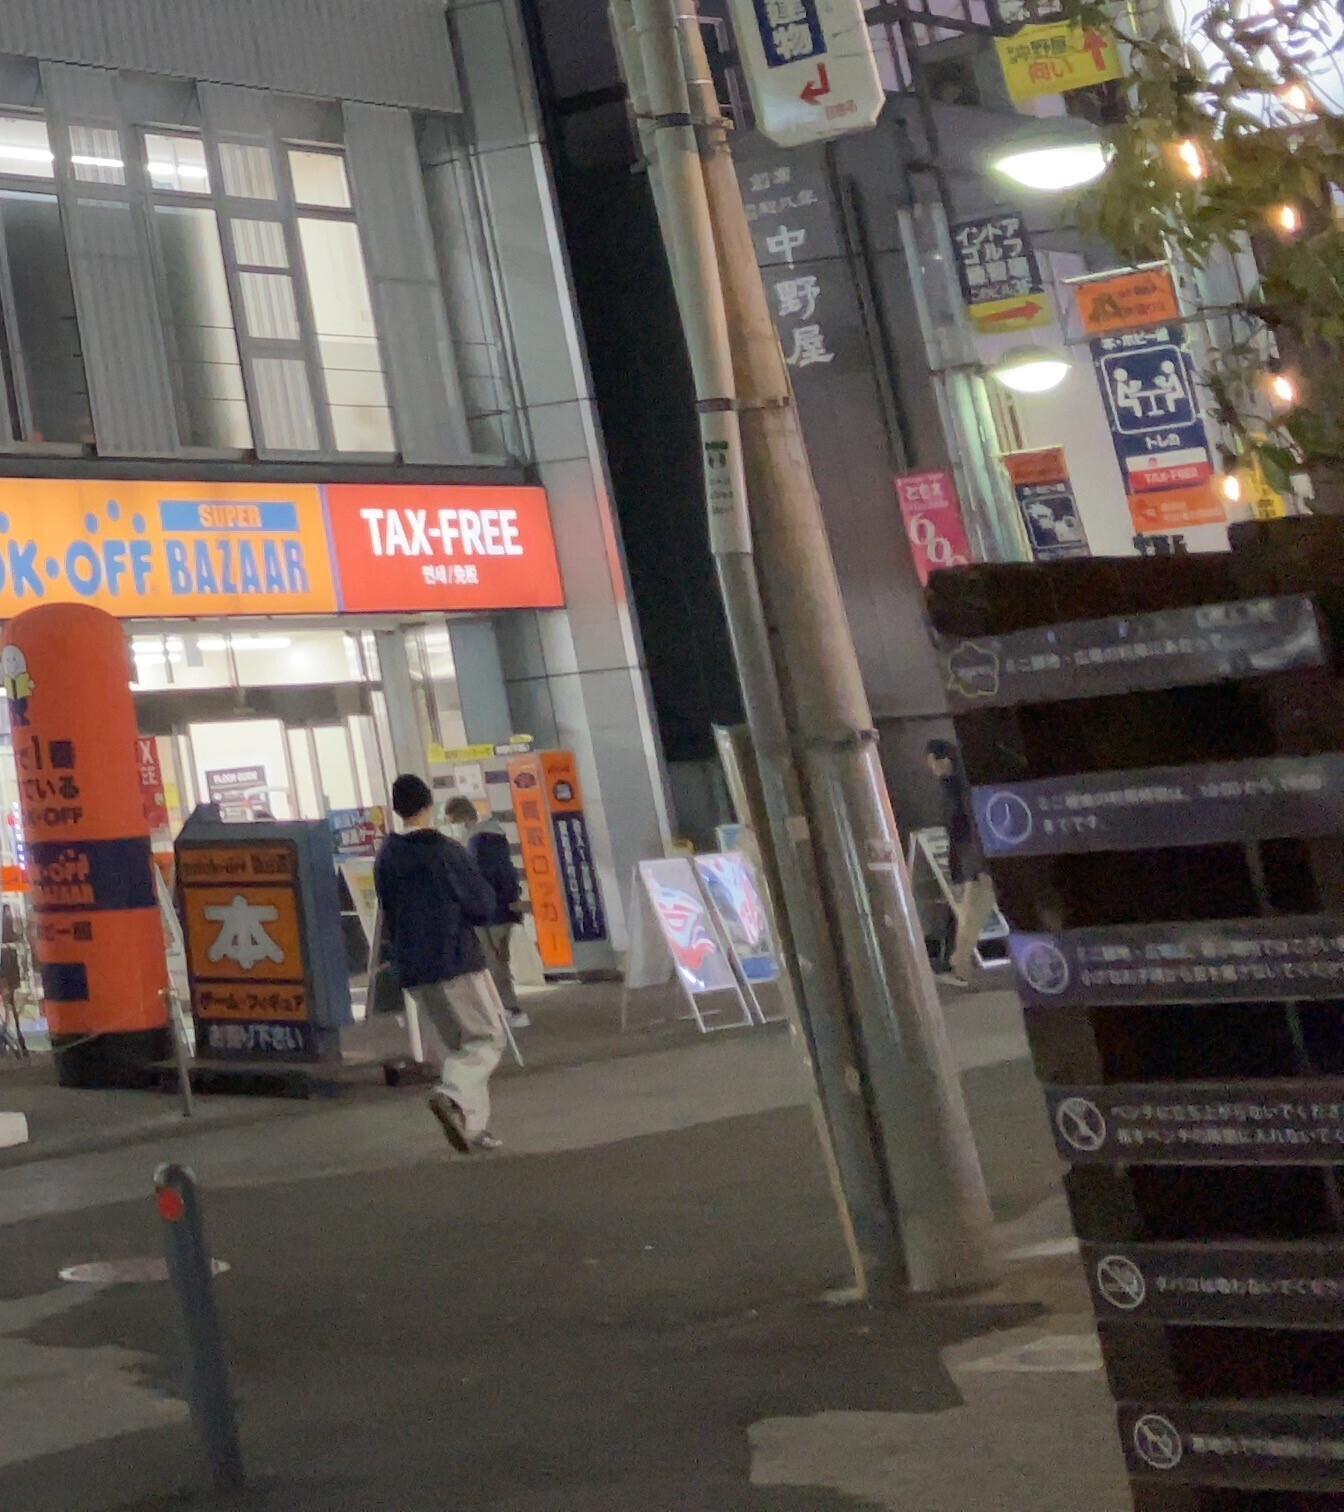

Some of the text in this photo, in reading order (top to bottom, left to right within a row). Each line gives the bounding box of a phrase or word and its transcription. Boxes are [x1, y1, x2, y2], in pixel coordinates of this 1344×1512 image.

[766, 224, 836, 368] 中野屋
[197, 503, 263, 528] SUPER
[359, 508, 524, 556] TAX-FREE
[163, 539, 311, 595] BAZAAR
[203, 893, 286, 970] 本
